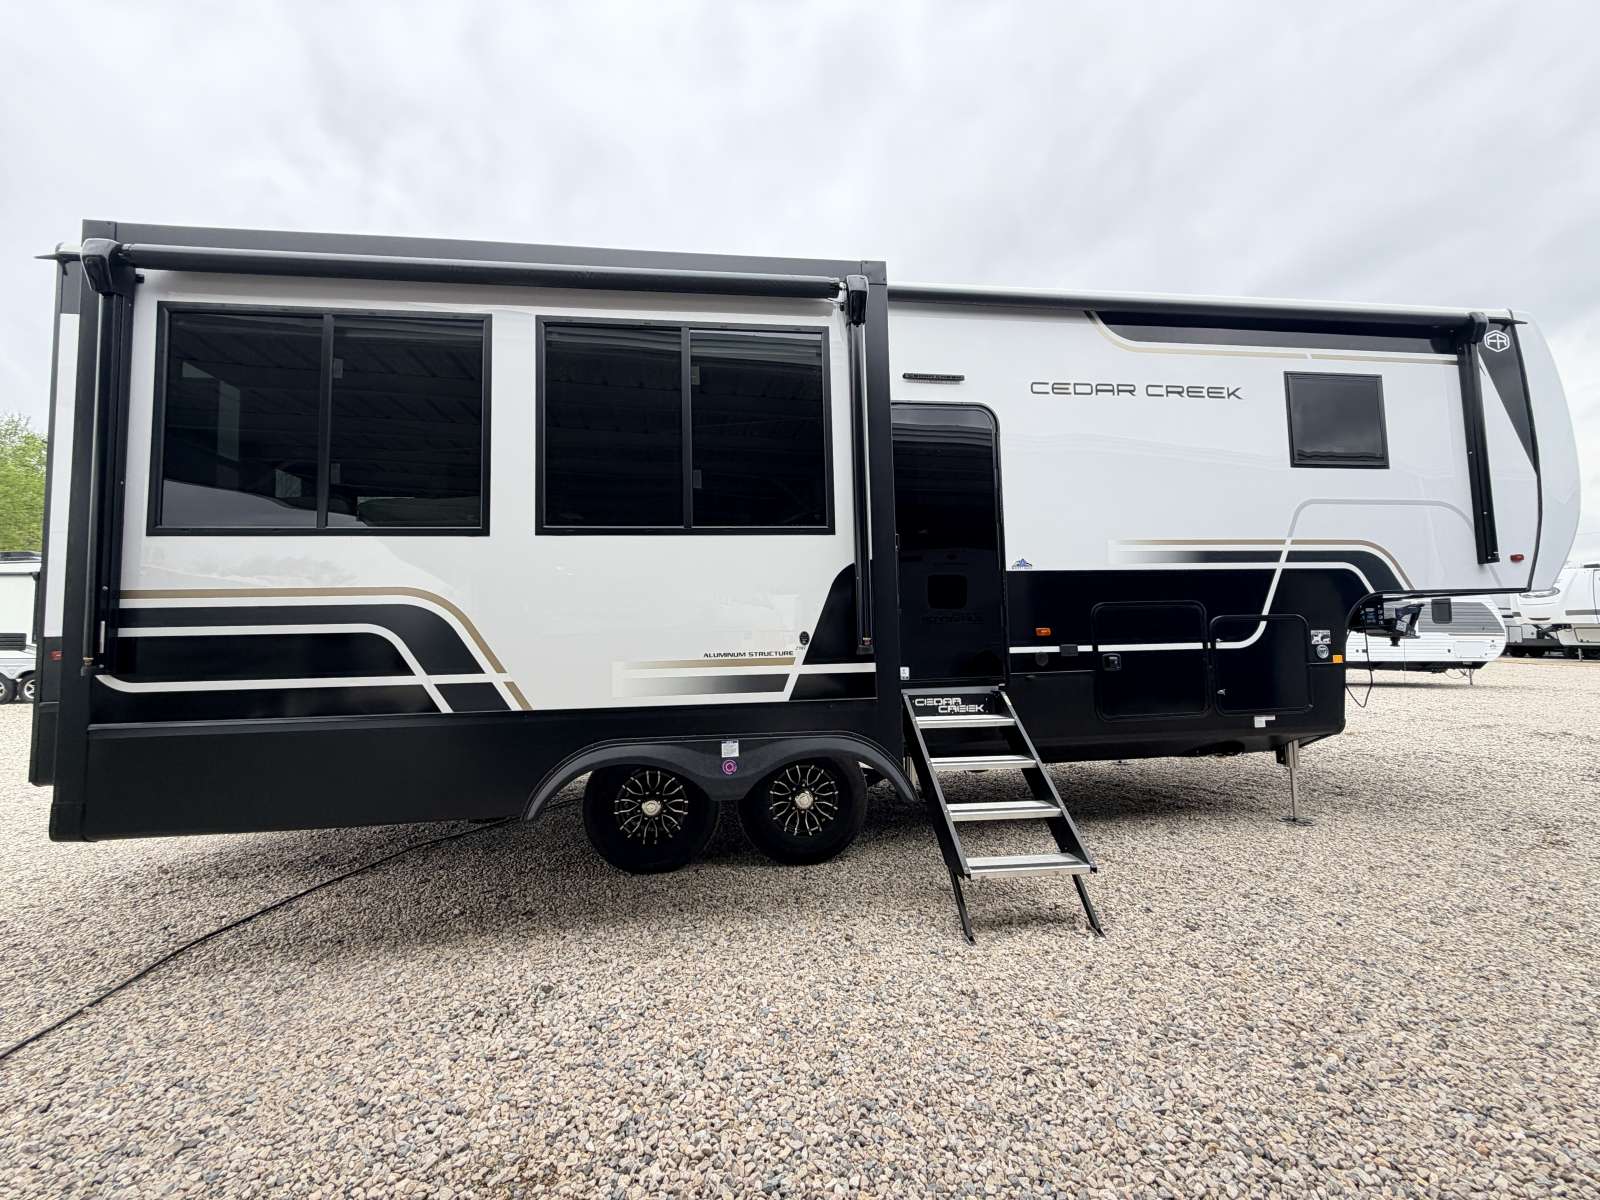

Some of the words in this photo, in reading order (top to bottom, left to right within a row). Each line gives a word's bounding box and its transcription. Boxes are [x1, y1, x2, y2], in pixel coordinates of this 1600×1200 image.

[1030, 381, 1137, 397] CEDAR
[1145, 384, 1244, 400] CREEK
[703, 651, 746, 659] ALUMINUM
[748, 650, 794, 658] STRUCTURE
[914, 697, 962, 706] CEDAR
[938, 704, 985, 713] CREEK
